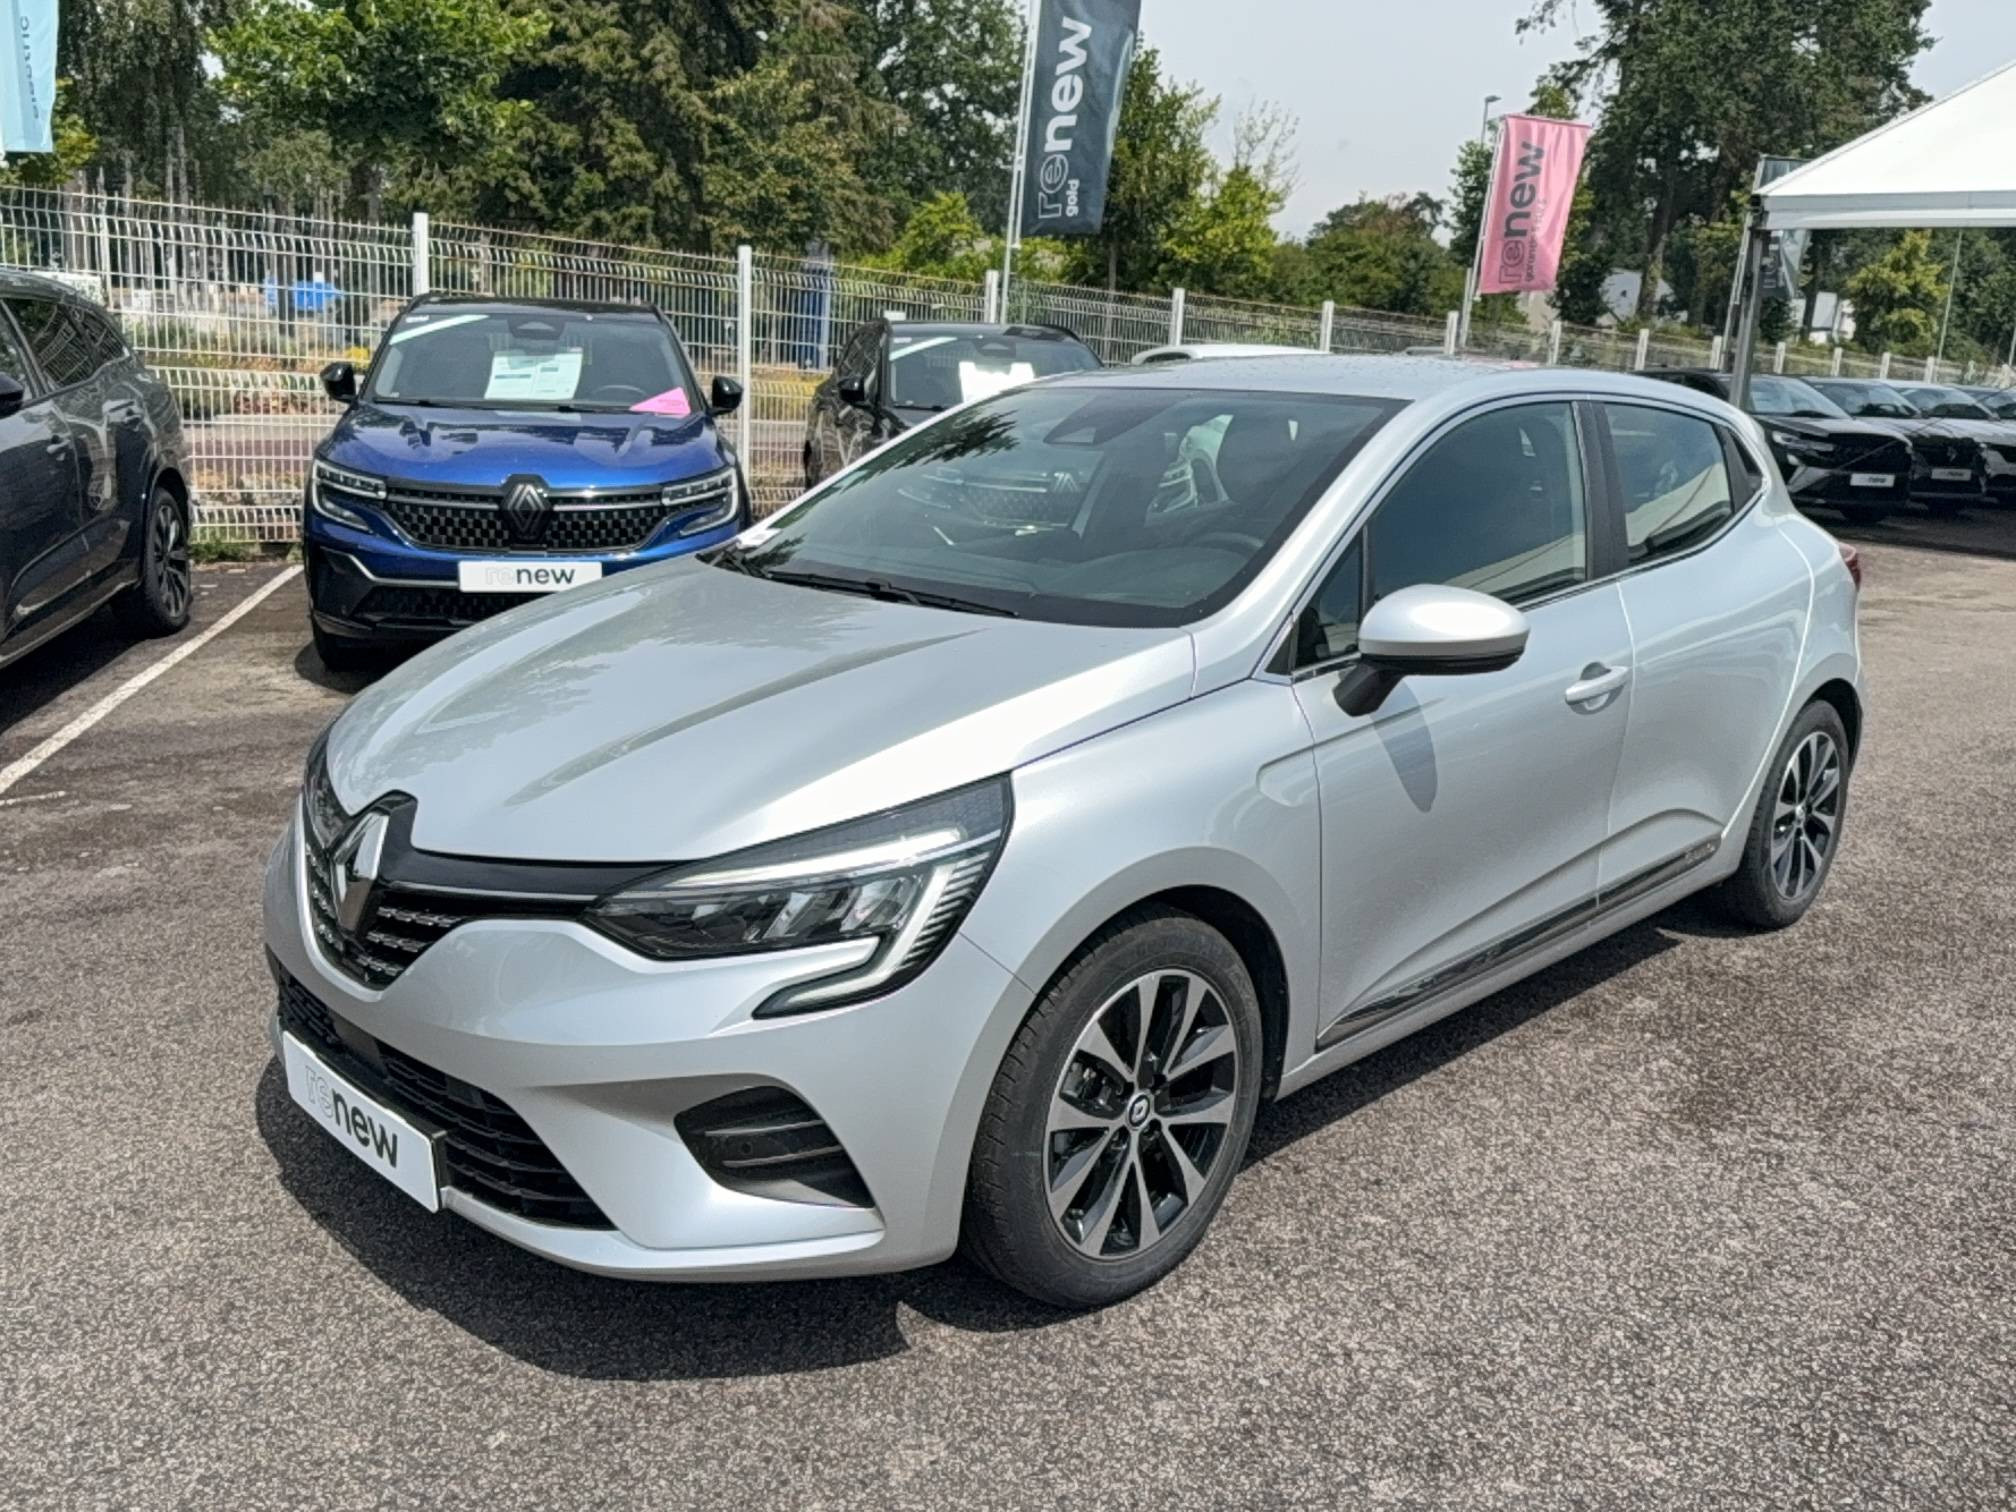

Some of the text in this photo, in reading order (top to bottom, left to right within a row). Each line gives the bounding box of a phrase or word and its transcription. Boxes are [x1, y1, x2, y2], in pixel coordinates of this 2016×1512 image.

[1038, 16, 1092, 218] renew
[1066, 178, 1080, 217] gold
[1499, 141, 1544, 284] renew
[485, 567, 575, 585] renew
[305, 1065, 398, 1168] renew
